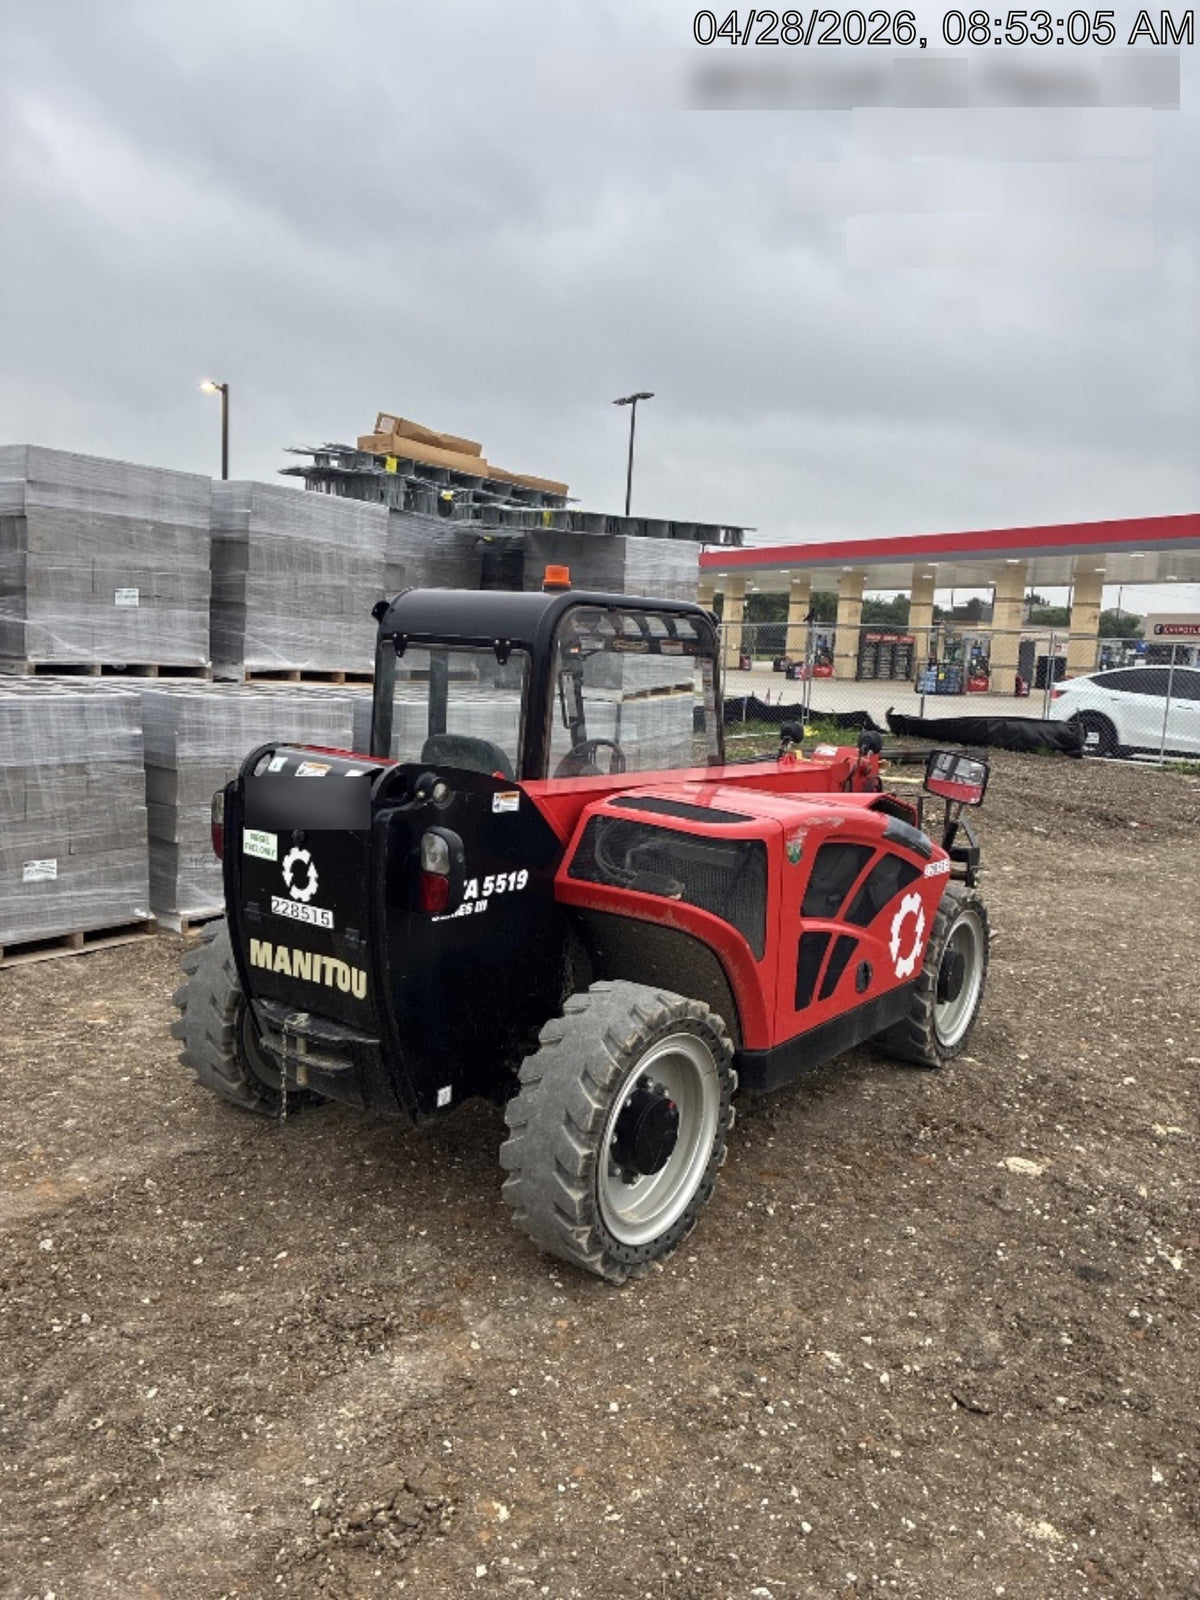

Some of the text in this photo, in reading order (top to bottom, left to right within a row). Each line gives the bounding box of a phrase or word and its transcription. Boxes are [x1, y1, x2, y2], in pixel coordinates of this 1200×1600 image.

[482, 868, 529, 897] 5519
[272, 899, 330, 926] 228515
[249, 938, 367, 1000] MANITOU
